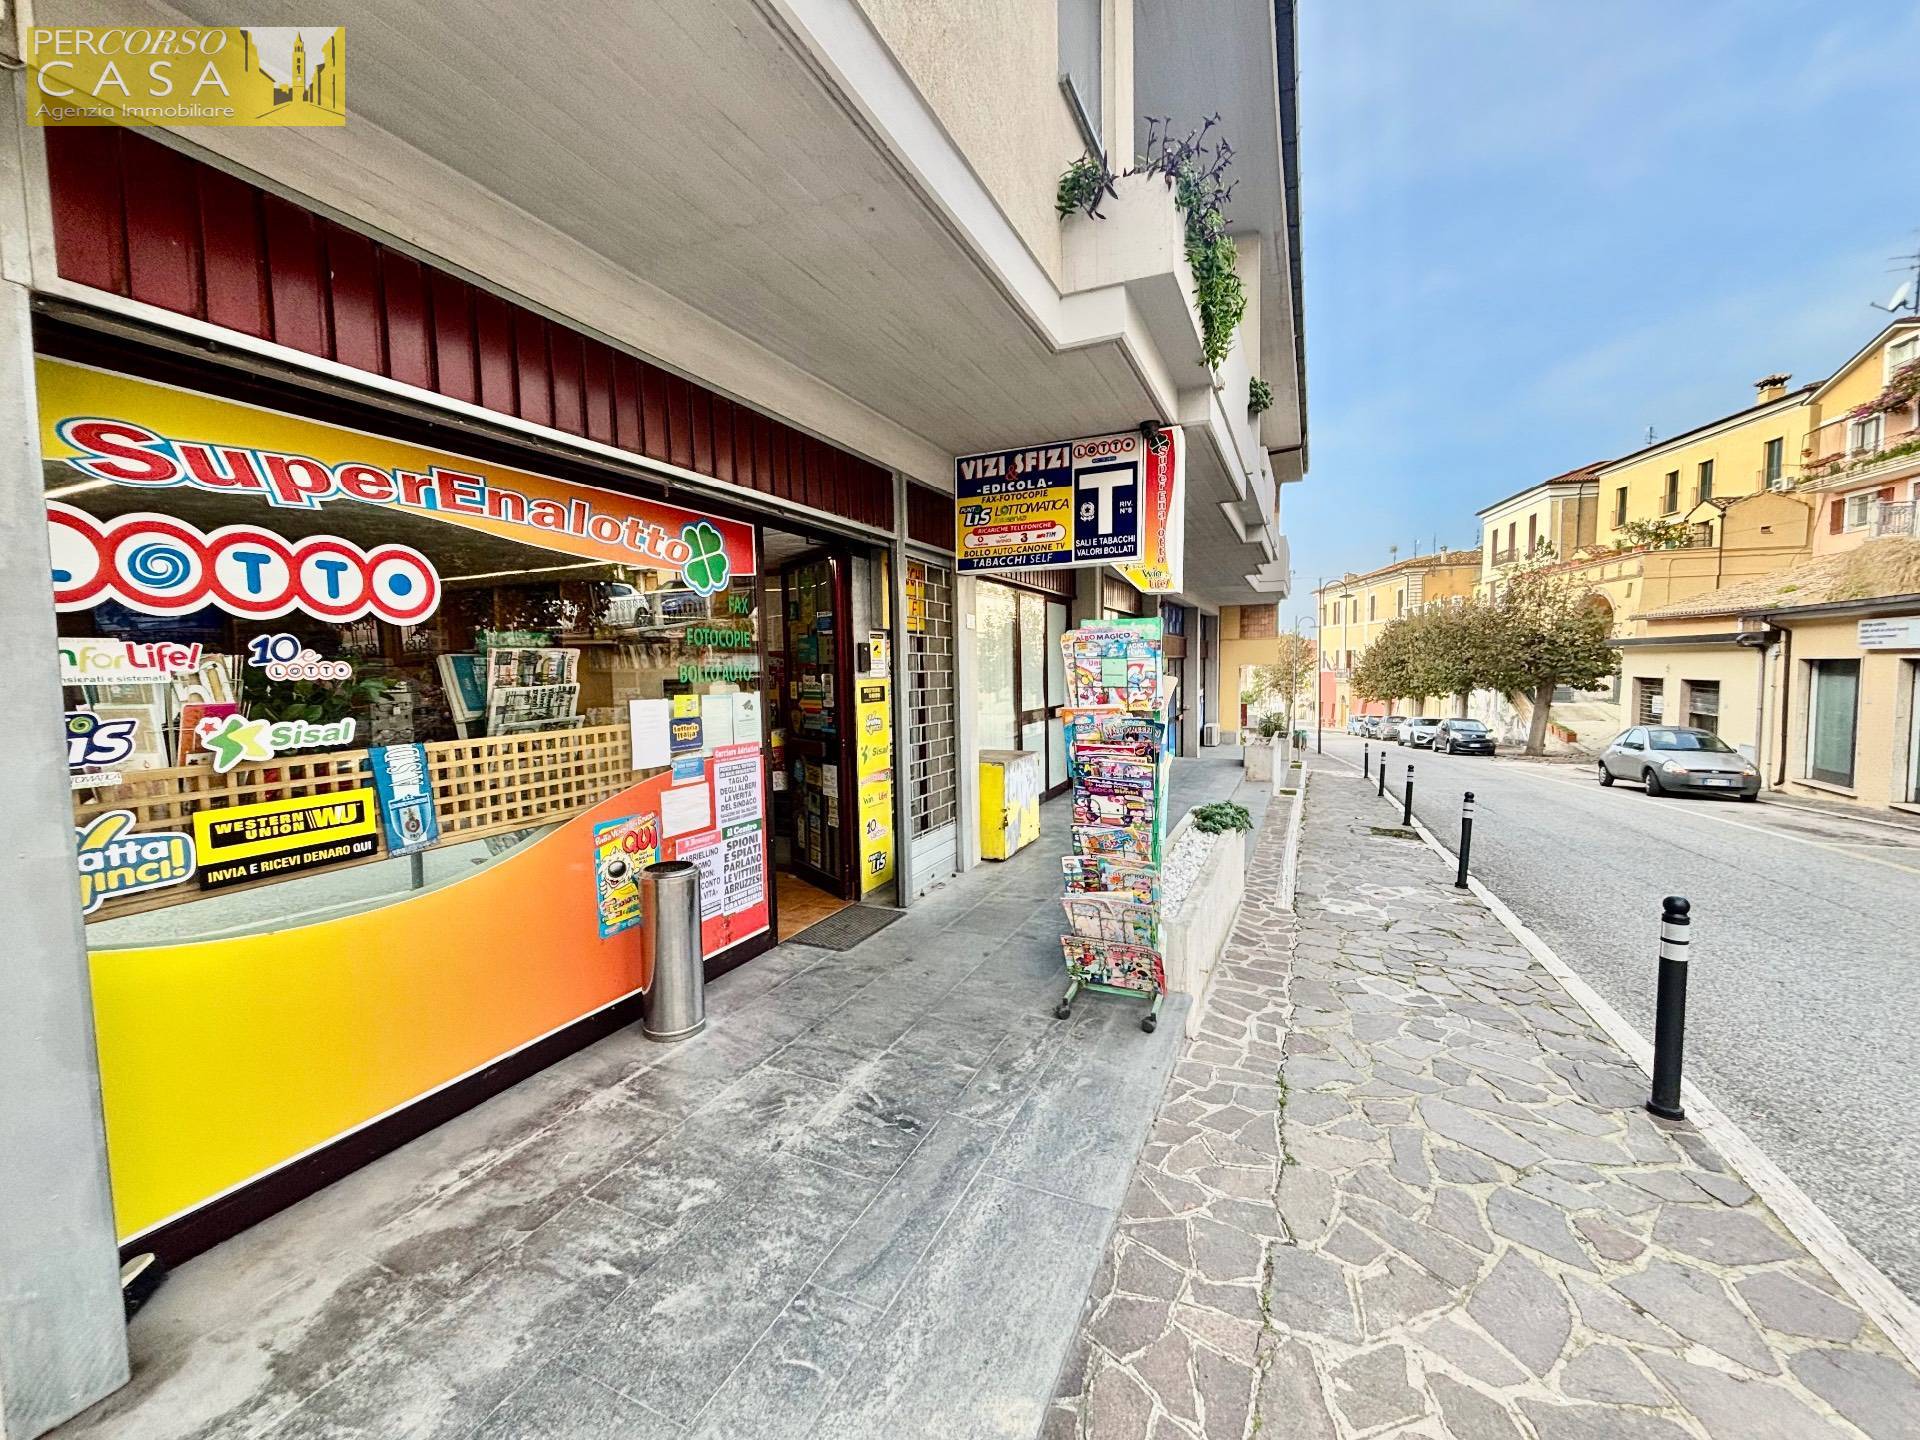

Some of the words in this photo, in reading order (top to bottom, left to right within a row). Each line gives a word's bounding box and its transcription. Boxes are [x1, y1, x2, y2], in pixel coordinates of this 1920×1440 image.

[1075, 439, 1134, 457] LOTTO
[961, 455, 1006, 480] VIZI
[1005, 464, 1018, 481] &
[1014, 446, 1070, 474] SFIZI
[57, 417, 692, 566] SuperEnalotto
[994, 498, 1070, 517] LOTTOMATICA
[1079, 468, 1134, 535] T
[977, 525, 1009, 534] RICARICHE
[1010, 522, 1052, 532] TELEFONICHE
[1075, 538, 1092, 547] SALI
[1099, 535, 1136, 545] TABACCHI
[964, 549, 991, 558] BOLLO
[992, 544, 1053, 555] AUTO-CANONE
[973, 556, 1027, 568] TABACCHI
[1030, 553, 1053, 563] SELF
[1076, 548, 1103, 557] VALORI
[1103, 545, 1134, 554] BOLLATI
[728, 595, 749, 614] FAX
[686, 627, 752, 648] FOTOCOPIE
[251, 636, 299, 664] 10
[270, 721, 351, 747] Sisal
[721, 802, 732, 812] DEL
[214, 811, 304, 835] WESTERN
[245, 821, 305, 840] UNION
[726, 834, 759, 851] SPIONI
[731, 843, 761, 860] SPIATI
[208, 866, 248, 883] INVIA
[250, 864, 258, 874] E
[260, 853, 301, 872] RICEVI
[303, 844, 351, 864] DENARO
[353, 840, 372, 853] QUI
[724, 854, 762, 874] PARLANO
[733, 864, 762, 881] VITTIME
[724, 874, 763, 895] ABRUZZESI
